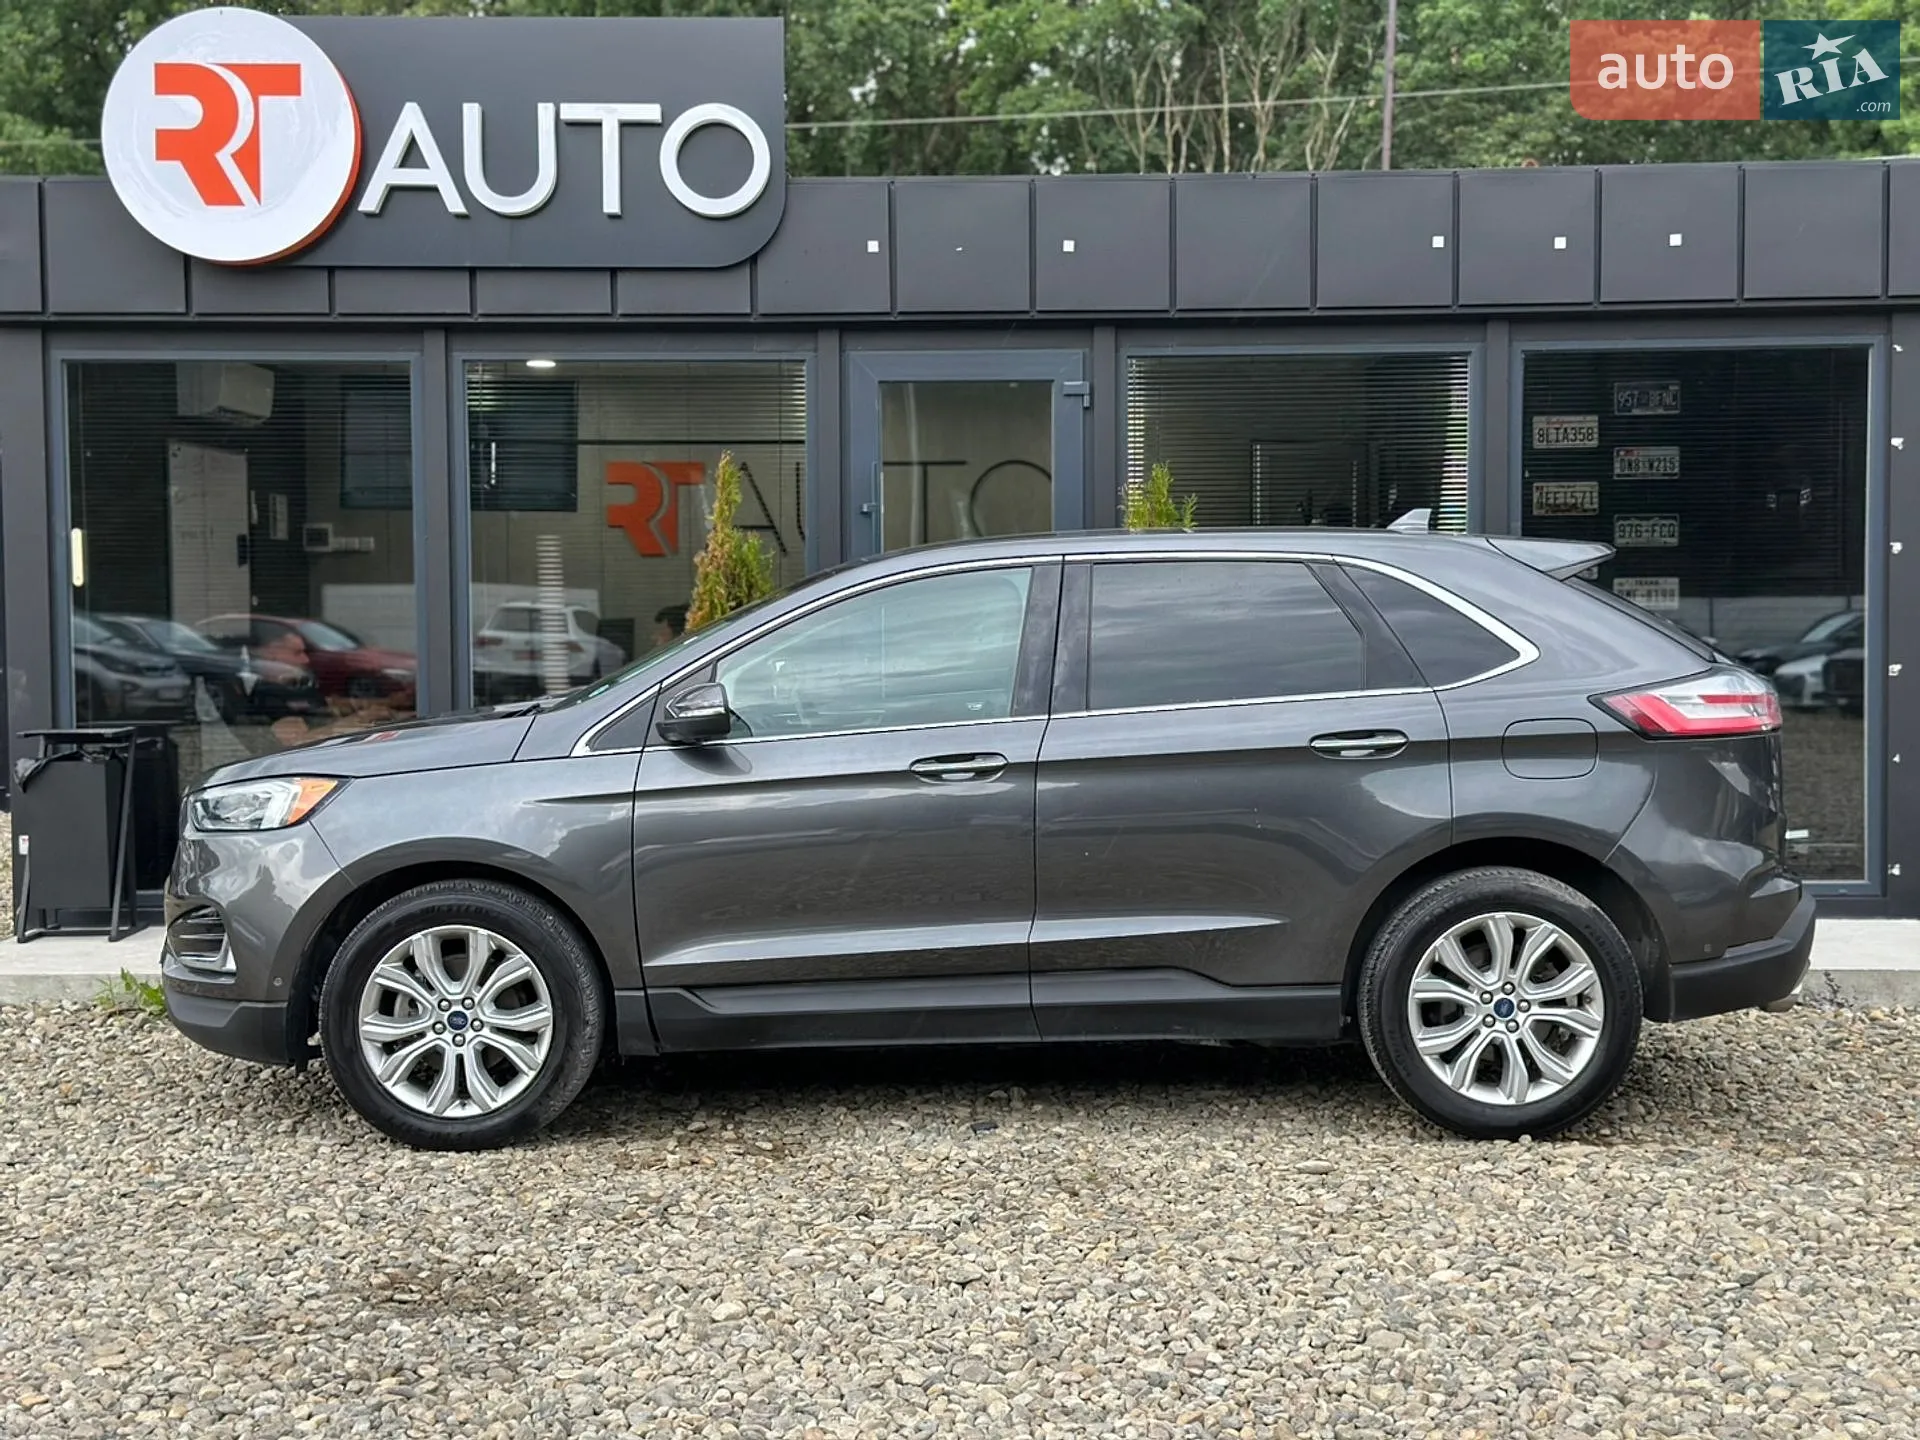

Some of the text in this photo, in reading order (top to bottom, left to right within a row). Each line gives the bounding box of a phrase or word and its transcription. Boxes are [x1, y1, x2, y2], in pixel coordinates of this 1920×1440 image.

[154, 63, 771, 218] RT AUTO
[607, 461, 705, 556] RT
